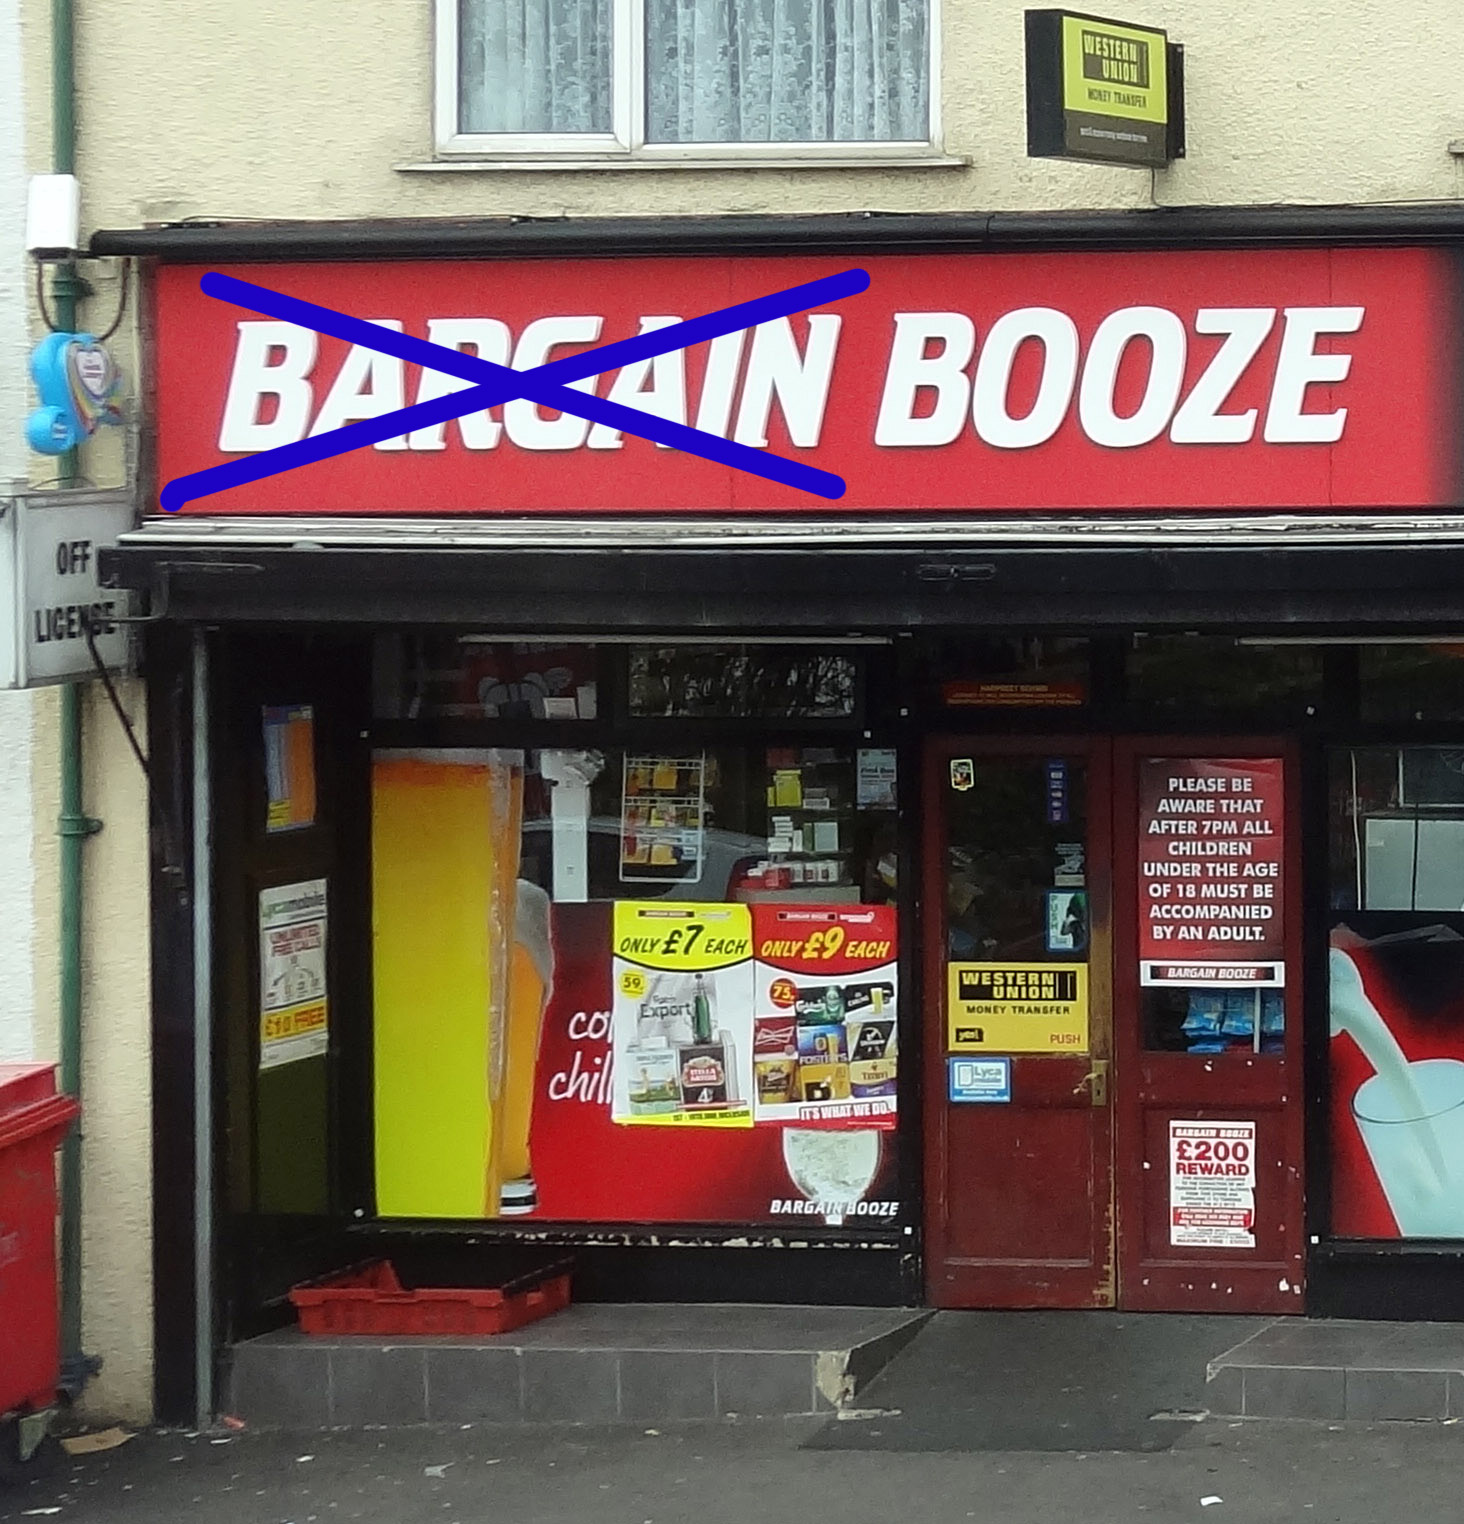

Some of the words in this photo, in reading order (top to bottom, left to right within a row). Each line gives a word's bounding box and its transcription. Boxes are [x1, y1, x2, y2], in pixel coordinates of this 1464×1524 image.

[1083, 33, 1138, 63] WESTERN
[1102, 58, 1138, 83] UNION
[1087, 87, 1112, 104] MONEY
[1113, 91, 1147, 108] TRANSFER
[219, 314, 842, 453] BARGAIN
[873, 305, 1365, 449] BOOZE
[56, 540, 92, 576] OFF
[1168, 778, 1226, 792] PLEASE
[1231, 778, 1252, 792] BE
[1157, 799, 1215, 813] AWARE
[1220, 799, 1264, 813] THAT
[1148, 820, 1198, 834] AFTER
[1202, 820, 1238, 834] 7PM
[1242, 820, 1273, 834] ALL
[1168, 841, 1252, 855] CHILDREN
[1143, 863, 1201, 877] UNDER
[1206, 863, 1238, 877] THE
[1242, 863, 1278, 877] AGE
[1148, 883, 1171, 898] OF
[1177, 884, 1196, 898] 18
[1200, 884, 1248, 898] MUST
[1253, 884, 1274, 898] BE
[1149, 904, 1273, 919] ACCOMPANIED
[620, 937, 660, 953] ONLY
[660, 924, 705, 955] £7
[704, 938, 748, 955] EACH
[1153, 926, 1174, 940] BY
[1177, 926, 1203, 940] AN
[1207, 926, 1266, 941] ADULT.
[761, 940, 803, 958] ONLY
[802, 926, 845, 960] £9
[845, 940, 891, 959] EACH
[961, 972, 1055, 986] WESTERN
[1167, 967, 1216, 979] BARGAIN
[1218, 967, 1258, 980] BOOZE
[992, 985, 1055, 999] UNION
[294, 1005, 325, 1029] FREE
[640, 1003, 692, 1021] Export
[966, 1005, 1007, 1015] MONEY
[1011, 1005, 1071, 1015] TRANSFER
[1049, 1033, 1081, 1044] PUSH
[973, 1065, 1002, 1077] Lyca
[820, 1104, 853, 1120] WHAT
[853, 1103, 870, 1117] WE
[1175, 1139, 1250, 1162] £200
[1175, 1162, 1250, 1176] REWARD
[769, 1199, 842, 1216] BARGAIN
[845, 1201, 900, 1216] BOOZE
